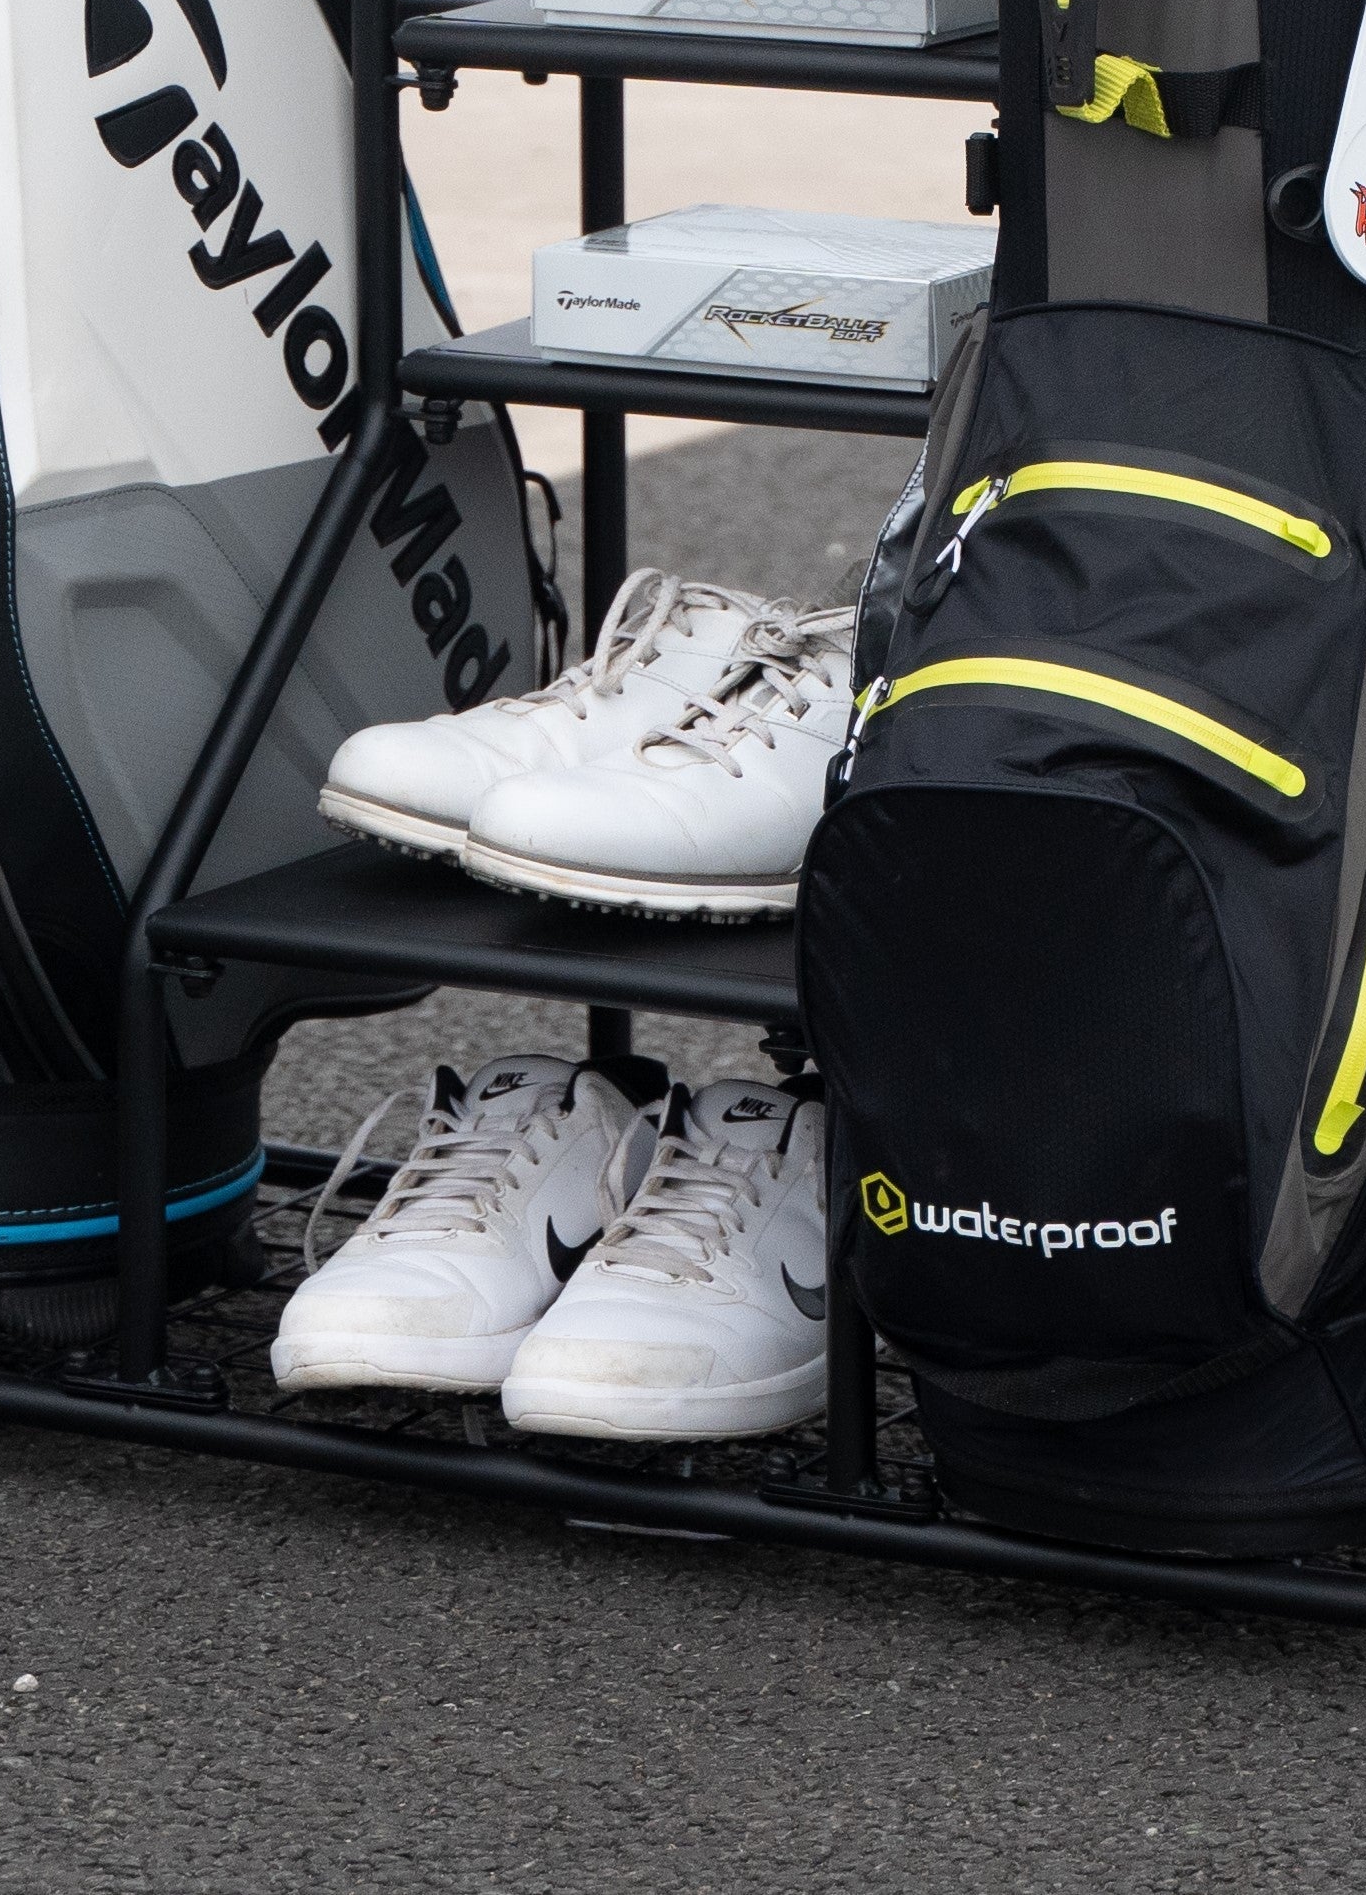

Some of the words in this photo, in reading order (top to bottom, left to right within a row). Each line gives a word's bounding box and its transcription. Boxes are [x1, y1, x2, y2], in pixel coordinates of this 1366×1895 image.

[556, 291, 641, 311] TaylorMade
[832, 328, 880, 343] SOFT
[489, 1071, 528, 1089] NIKE
[734, 1096, 778, 1118] NIKE
[913, 1201, 1178, 1258] waterproof
